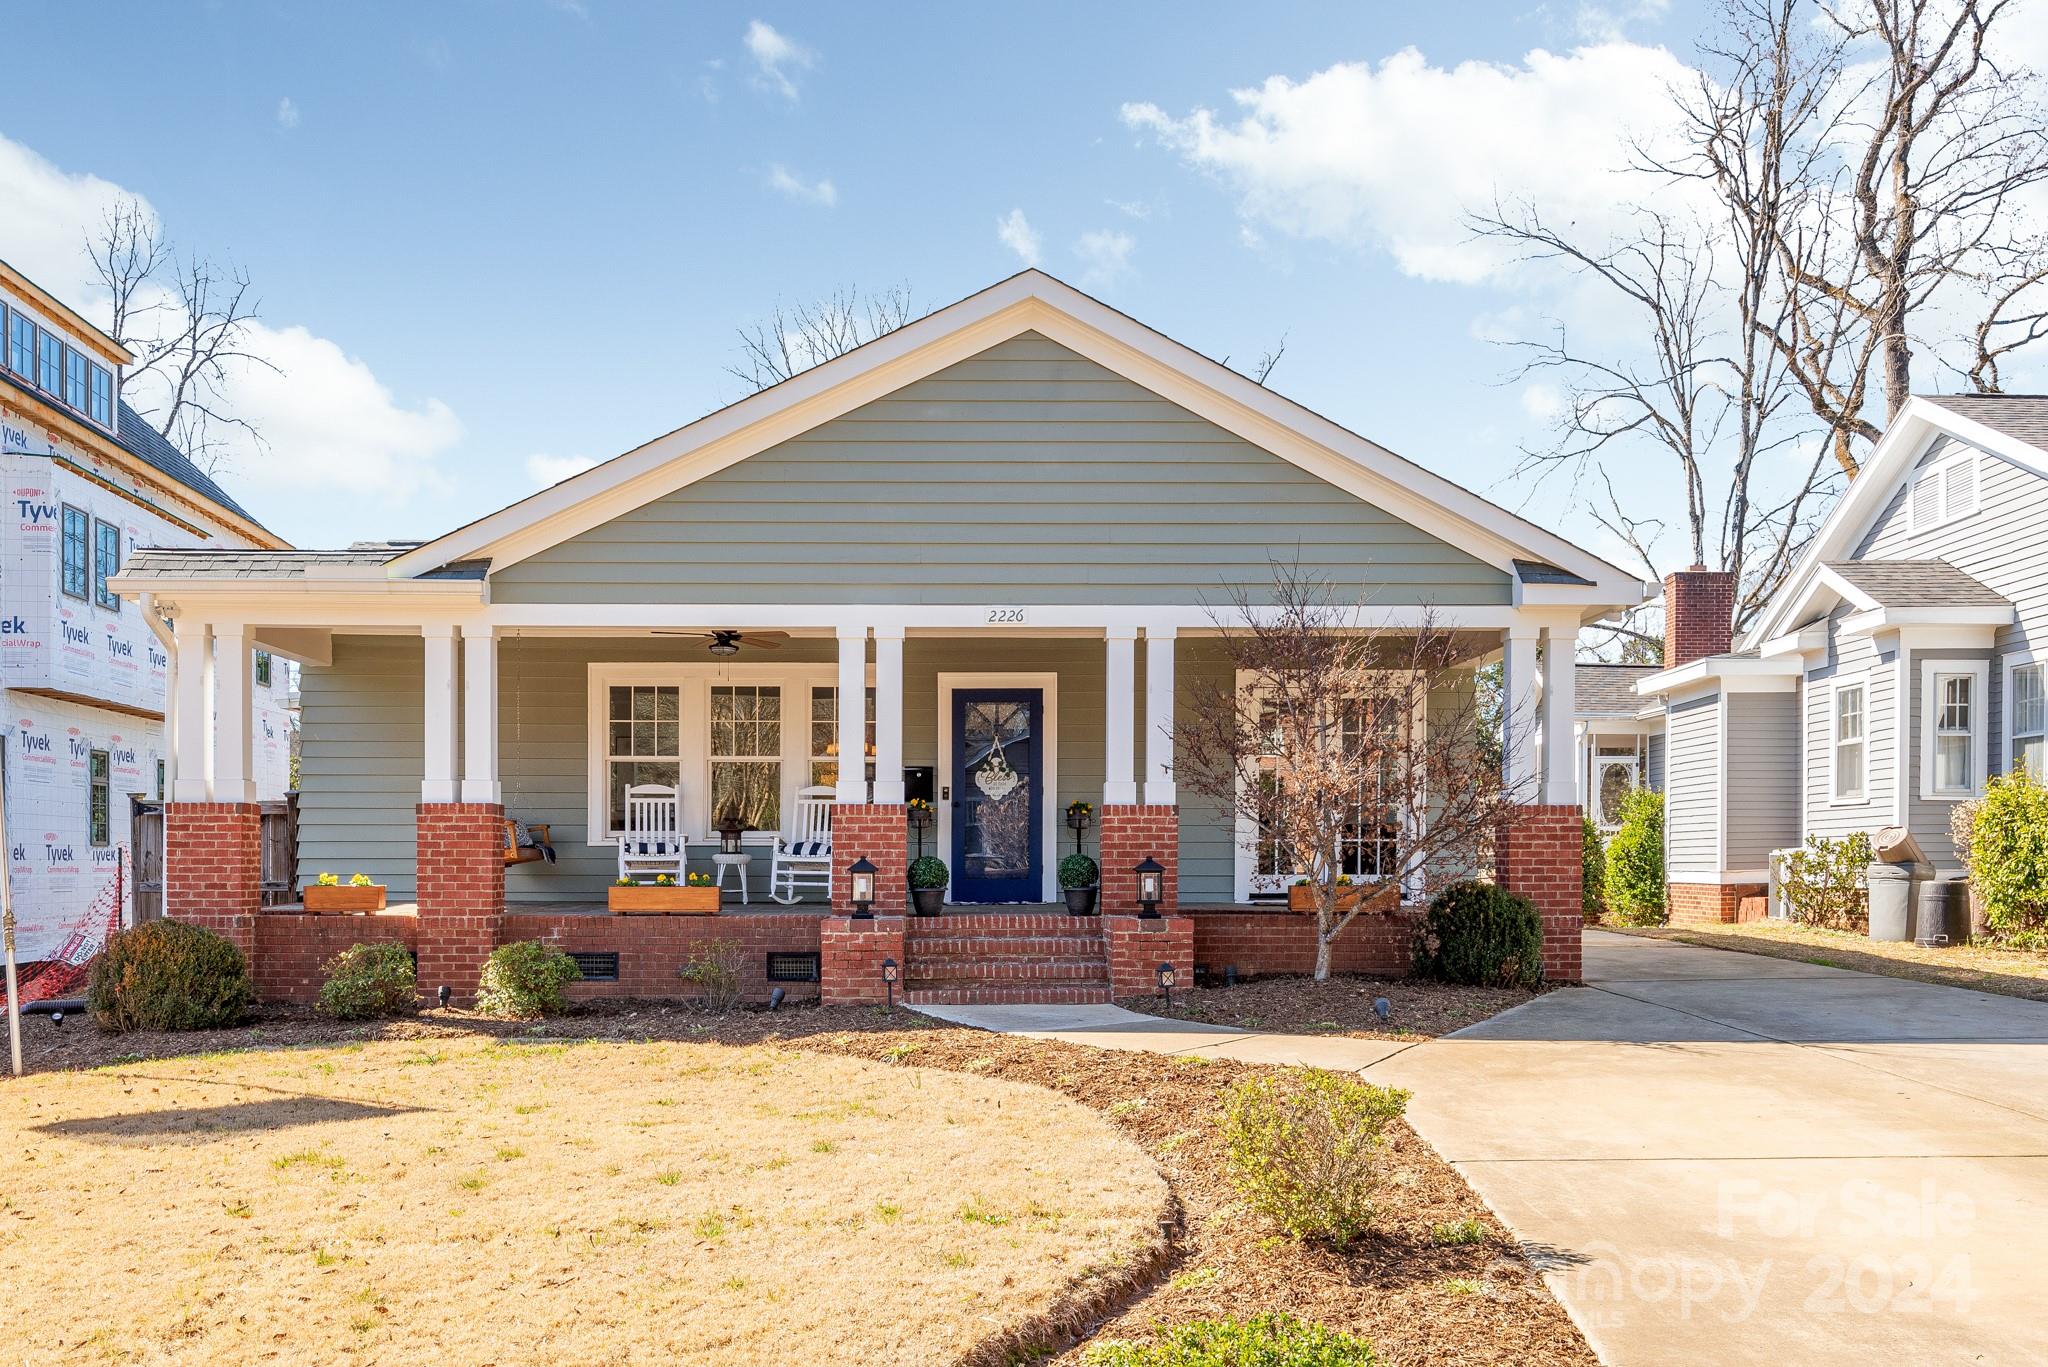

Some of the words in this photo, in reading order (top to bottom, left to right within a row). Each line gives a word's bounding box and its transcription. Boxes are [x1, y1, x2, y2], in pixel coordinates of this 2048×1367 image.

[1, 425, 28, 449] yvek
[988, 608, 1024, 622] 2226
[61, 620, 90, 645] Tyvek
[107, 634, 132, 657] Tyvek
[21, 730, 51, 754] Tyvek
[46, 844, 73, 866] Tyvek
